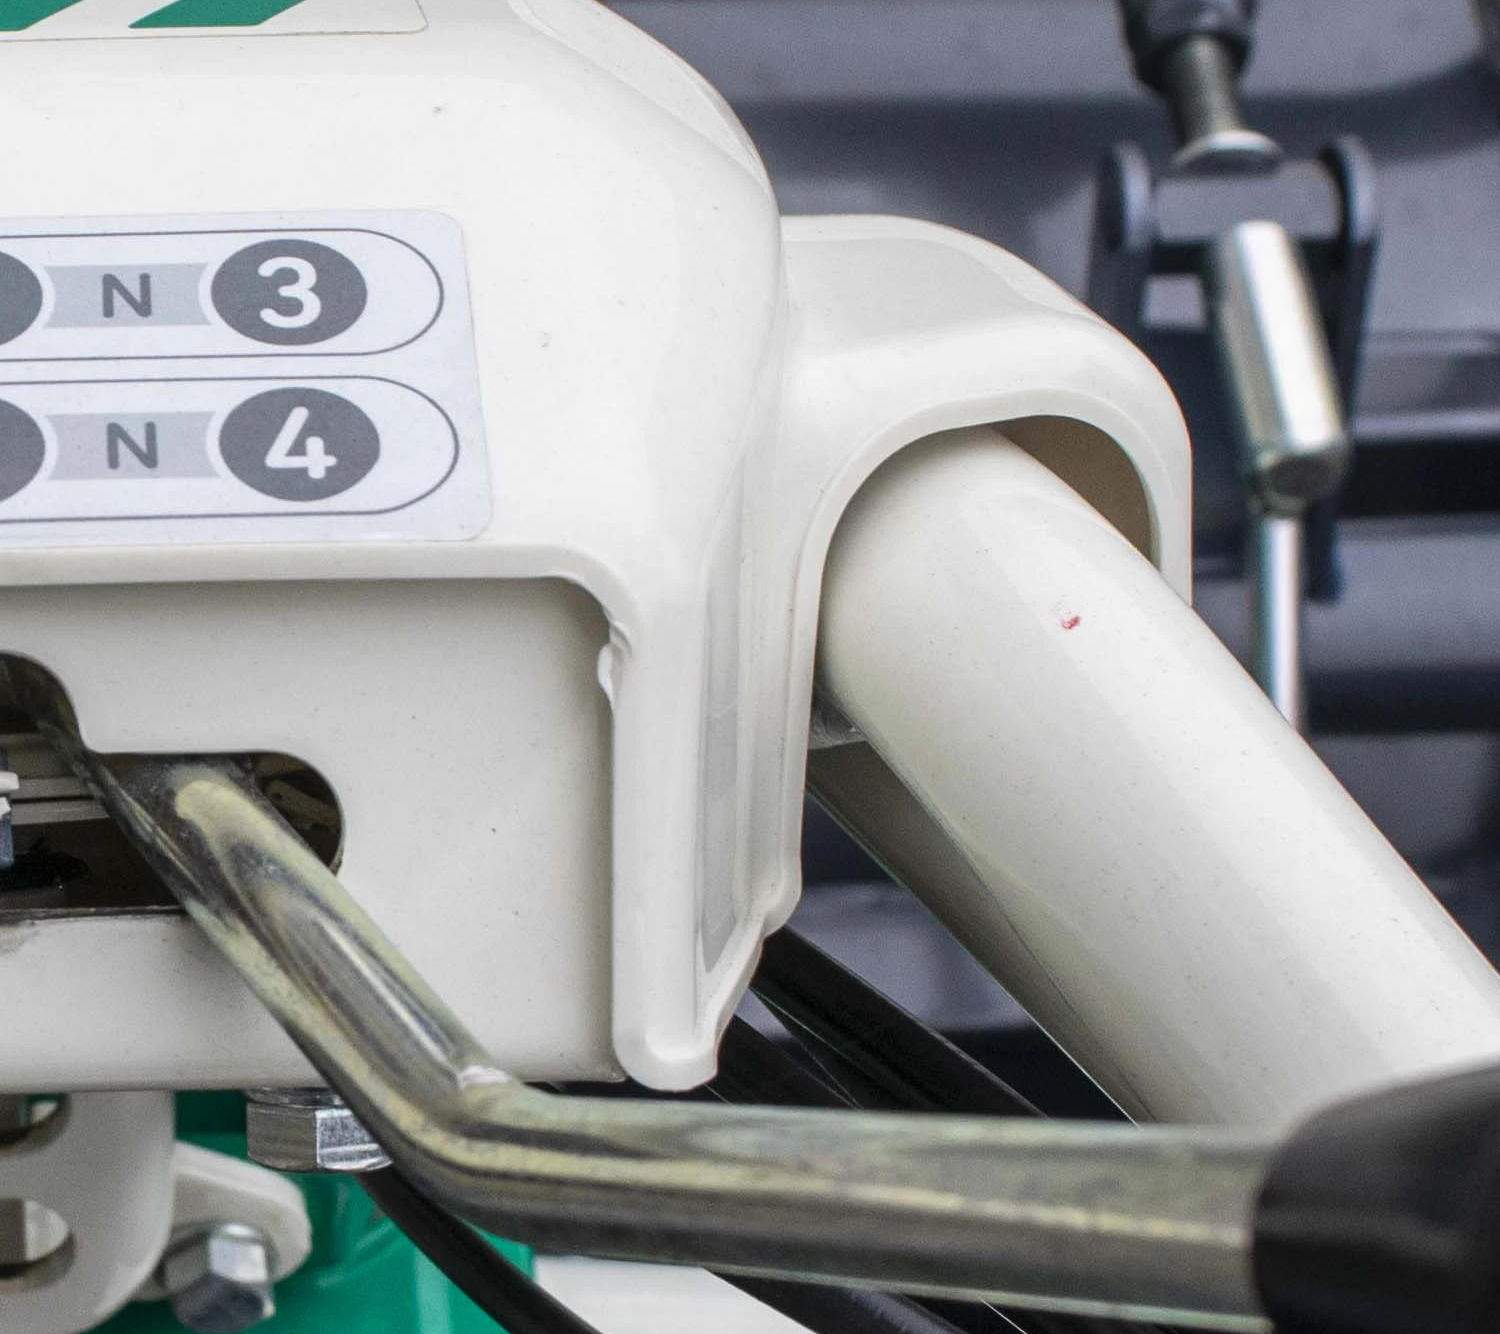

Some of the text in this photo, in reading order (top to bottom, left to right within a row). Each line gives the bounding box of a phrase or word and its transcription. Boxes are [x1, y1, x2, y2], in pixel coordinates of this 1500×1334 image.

[102, 273, 152, 318] N
[258, 257, 321, 328] 3
[107, 422, 158, 469] N
[265, 407, 336, 479] 4
